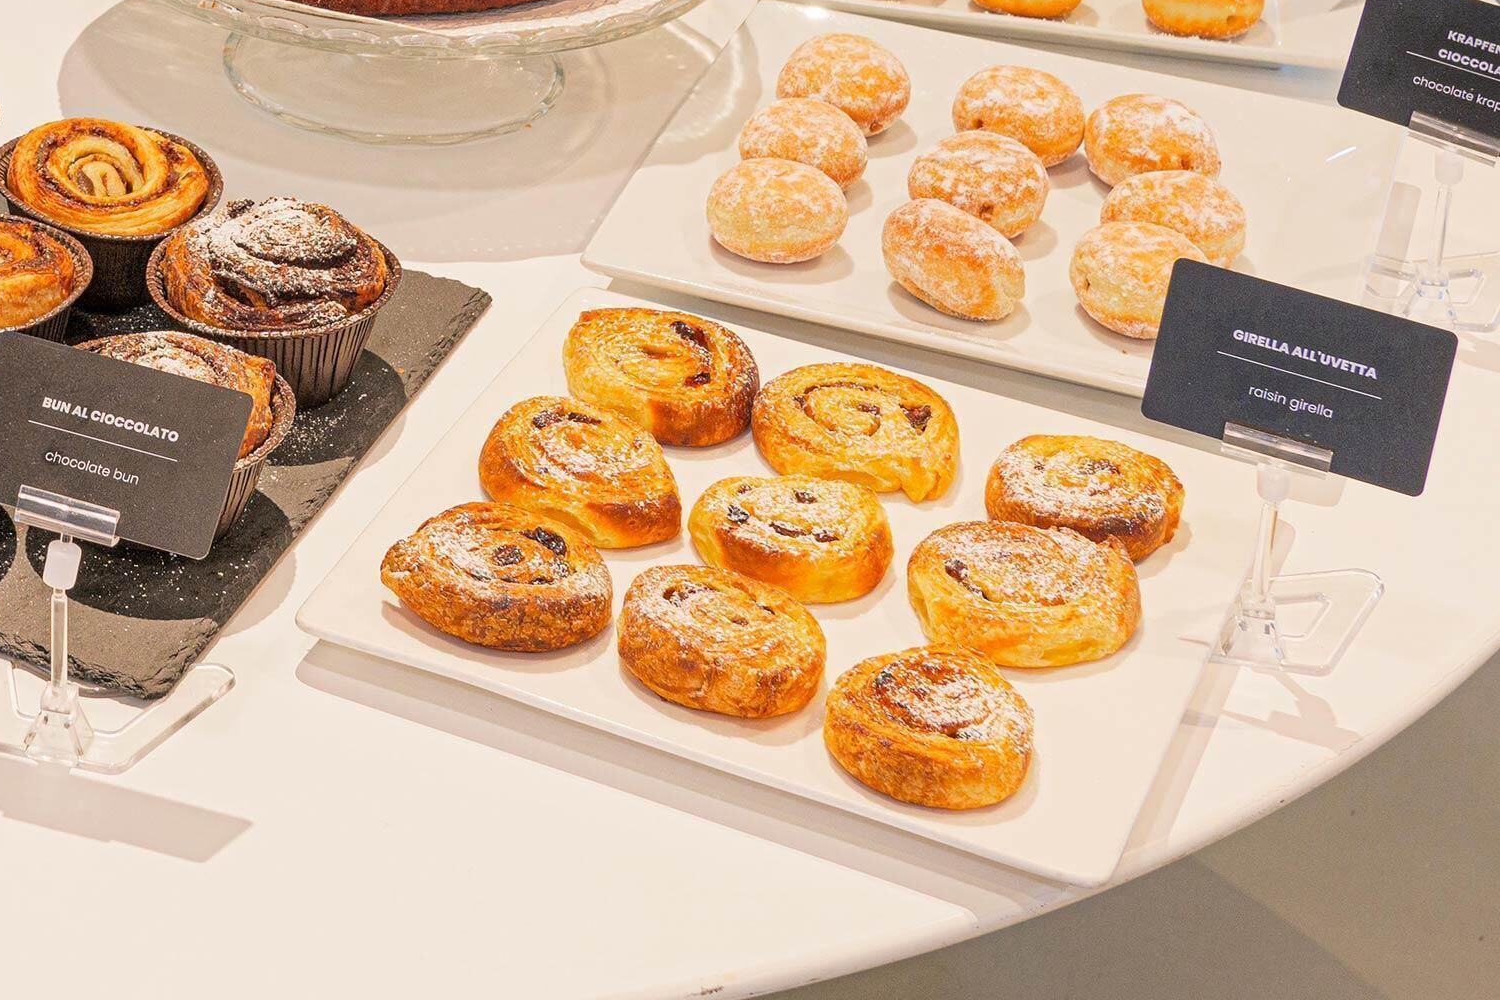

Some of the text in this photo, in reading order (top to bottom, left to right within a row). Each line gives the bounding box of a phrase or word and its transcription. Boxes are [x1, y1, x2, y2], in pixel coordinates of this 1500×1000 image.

[1412, 76, 1474, 102] chocolate
[1233, 329, 1378, 380] GIRELLA ALL'UVETTA
[41, 396, 179, 442] BUN AL CIOCCOLATO
[1248, 386, 1334, 419] raisin girella
[45, 451, 139, 485] chocolate bun
